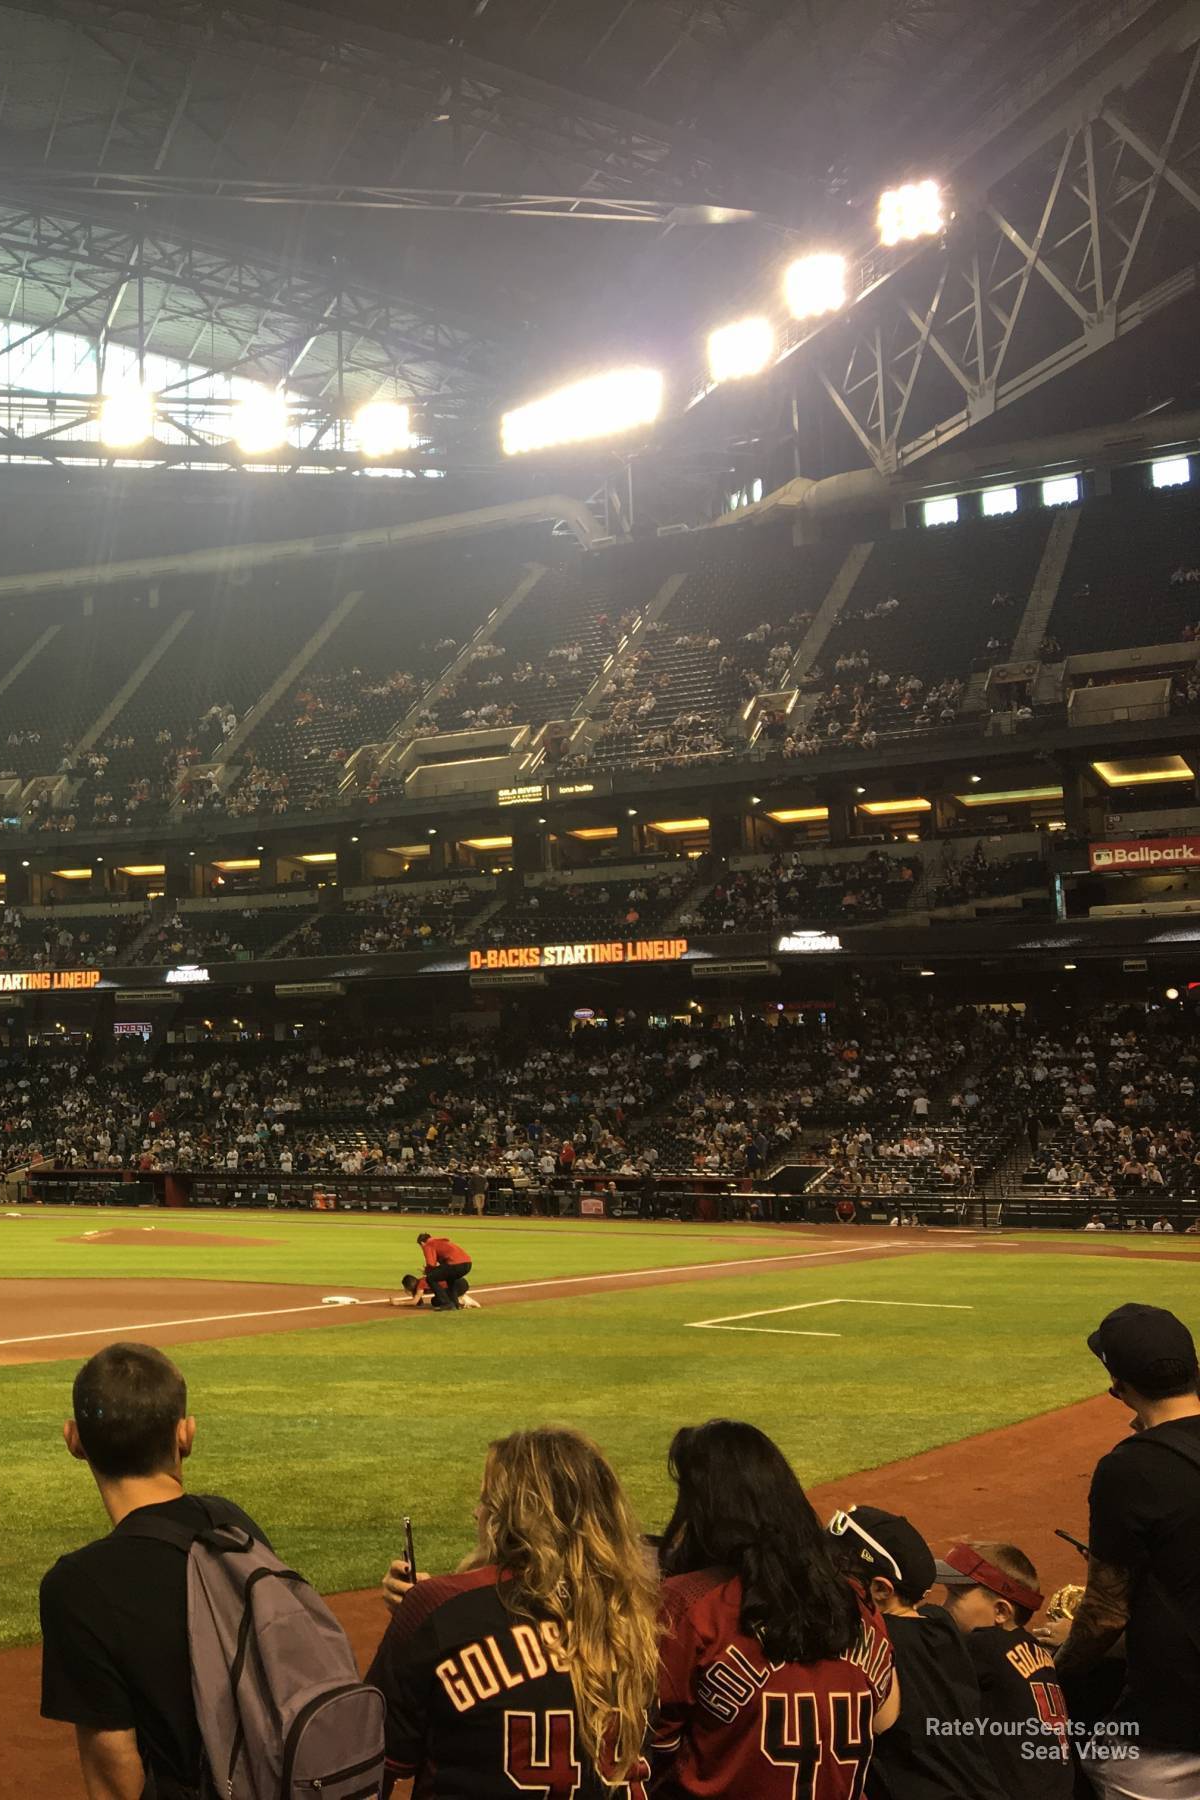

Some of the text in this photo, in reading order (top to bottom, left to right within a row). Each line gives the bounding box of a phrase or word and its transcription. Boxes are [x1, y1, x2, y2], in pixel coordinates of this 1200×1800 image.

[1114, 844, 1195, 864] Ballpark
[469, 948, 540, 970] D-BACKS
[542, 943, 623, 966] STARTING
[626, 939, 688, 961] LINEUP
[53, 971, 100, 989] LINEUP
[761, 1691, 874, 1800] 44
